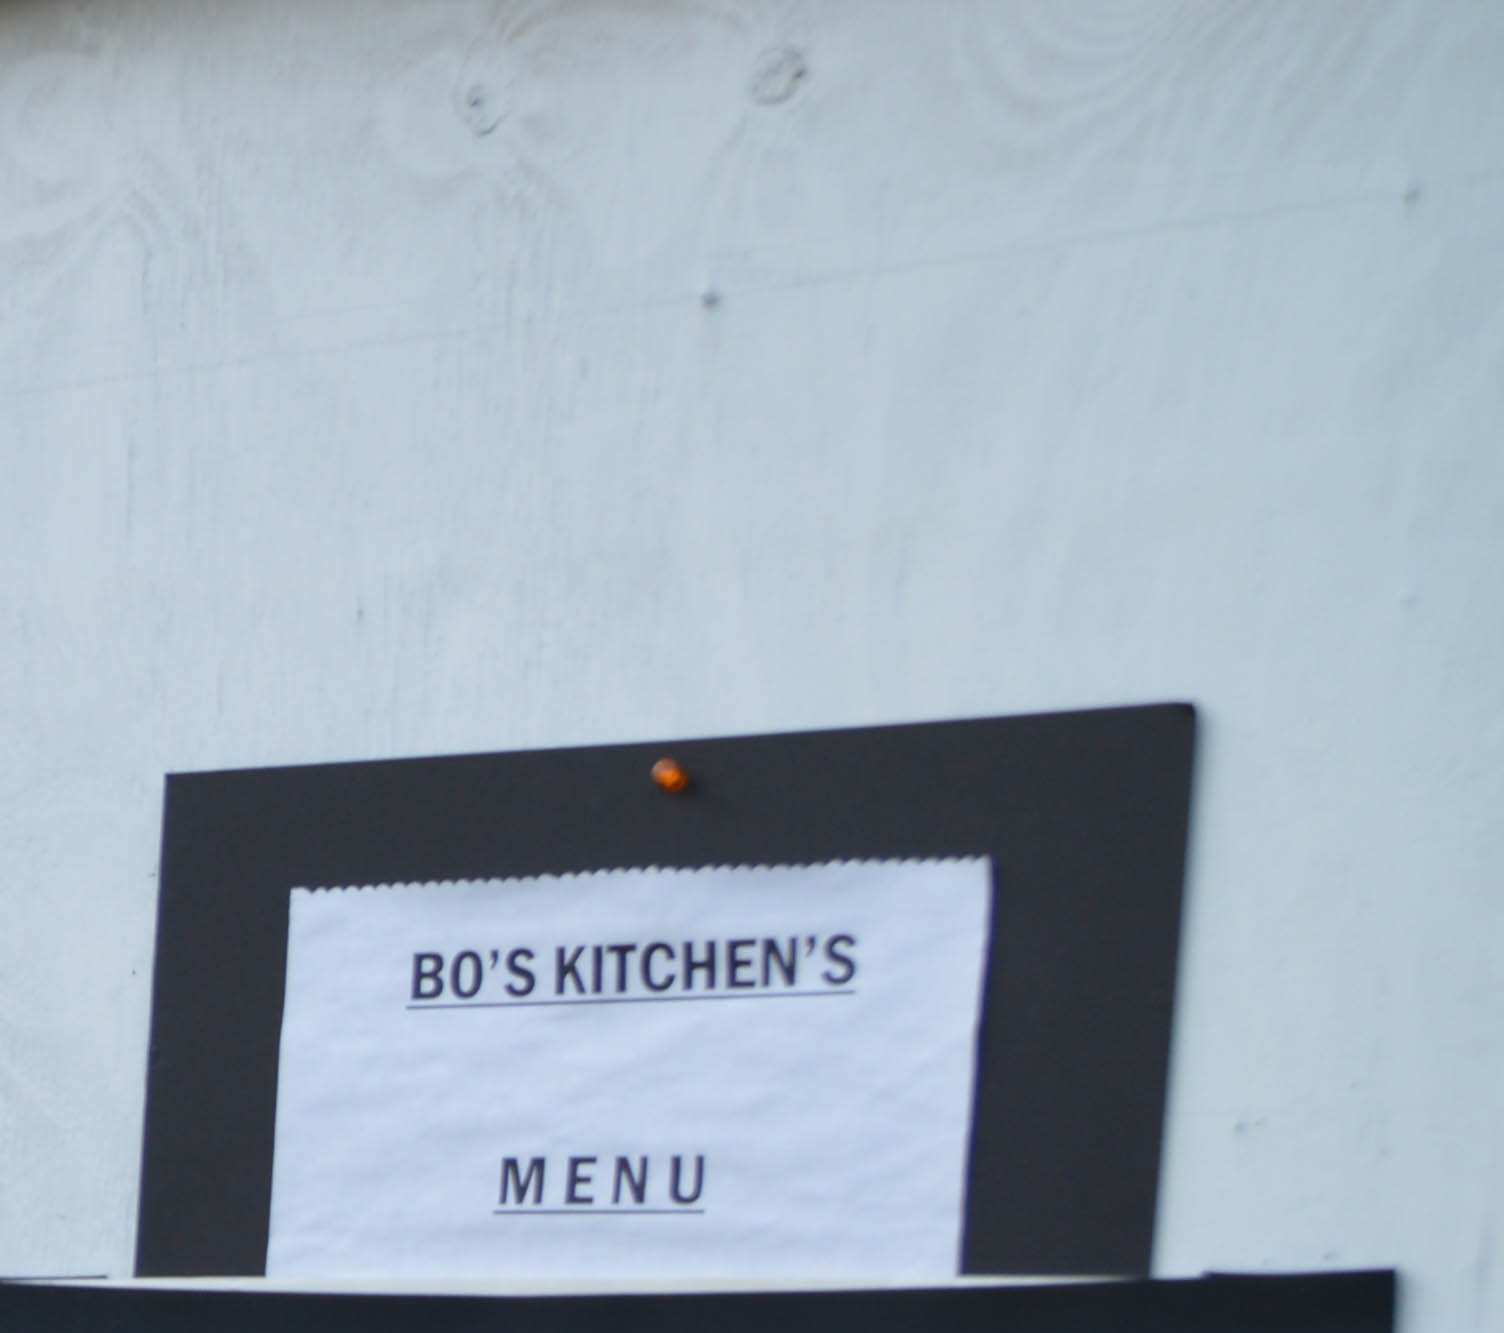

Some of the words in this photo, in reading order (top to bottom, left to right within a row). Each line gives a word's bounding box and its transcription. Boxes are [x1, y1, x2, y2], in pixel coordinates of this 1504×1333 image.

[408, 946, 537, 1001] BO'S
[554, 933, 859, 995] KITCHEN'S
[497, 1153, 709, 1207] MENU
